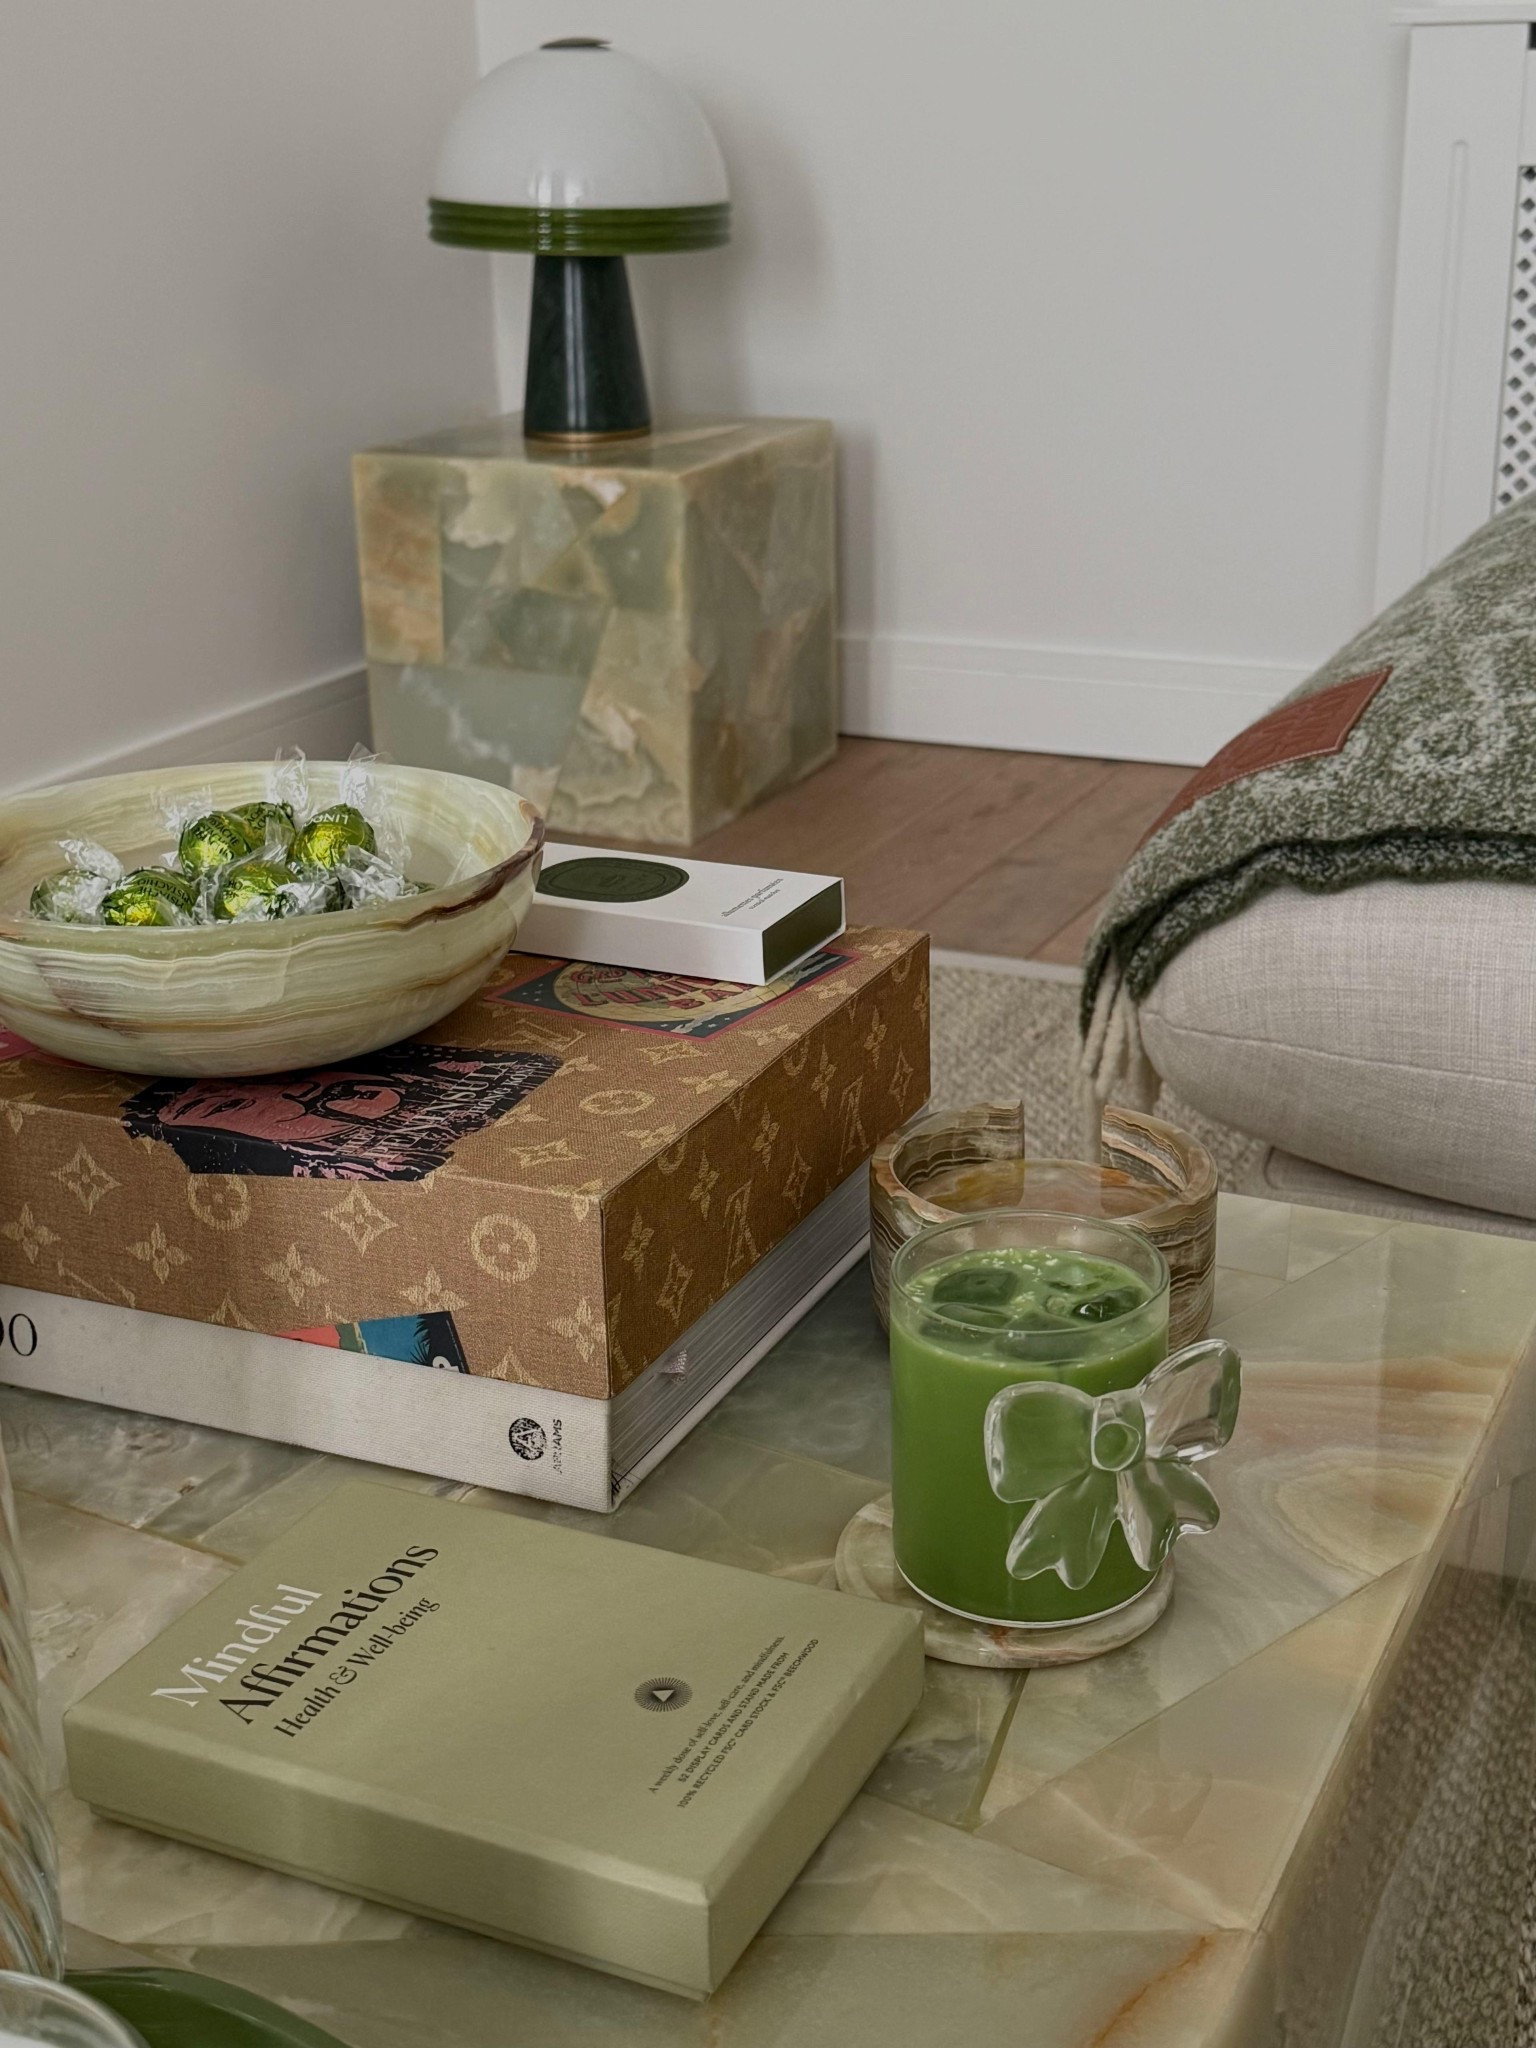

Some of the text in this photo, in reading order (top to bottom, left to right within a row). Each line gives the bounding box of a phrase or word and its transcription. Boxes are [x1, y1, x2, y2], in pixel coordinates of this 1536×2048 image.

[359, 1060, 519, 1160] PENINSULA
[468, 1087, 512, 1115] HONG
[151, 1583, 323, 1708] Mindful
[218, 1545, 439, 1725] Affirmations
[273, 1597, 440, 1738] Health & Well-being
[673, 1746, 692, 1764] dose
[741, 1669, 755, 1684] and
[676, 1789, 698, 1808] 100%
[692, 1753, 726, 1790] RECYCLED
[734, 1719, 754, 1738] CARD
[749, 1697, 772, 1719] STOCK
[784, 1638, 819, 1677] BEECHWOOD
[678, 1652, 790, 1783] 52 DISPLAY CARDS AND STAND MADE FROM
